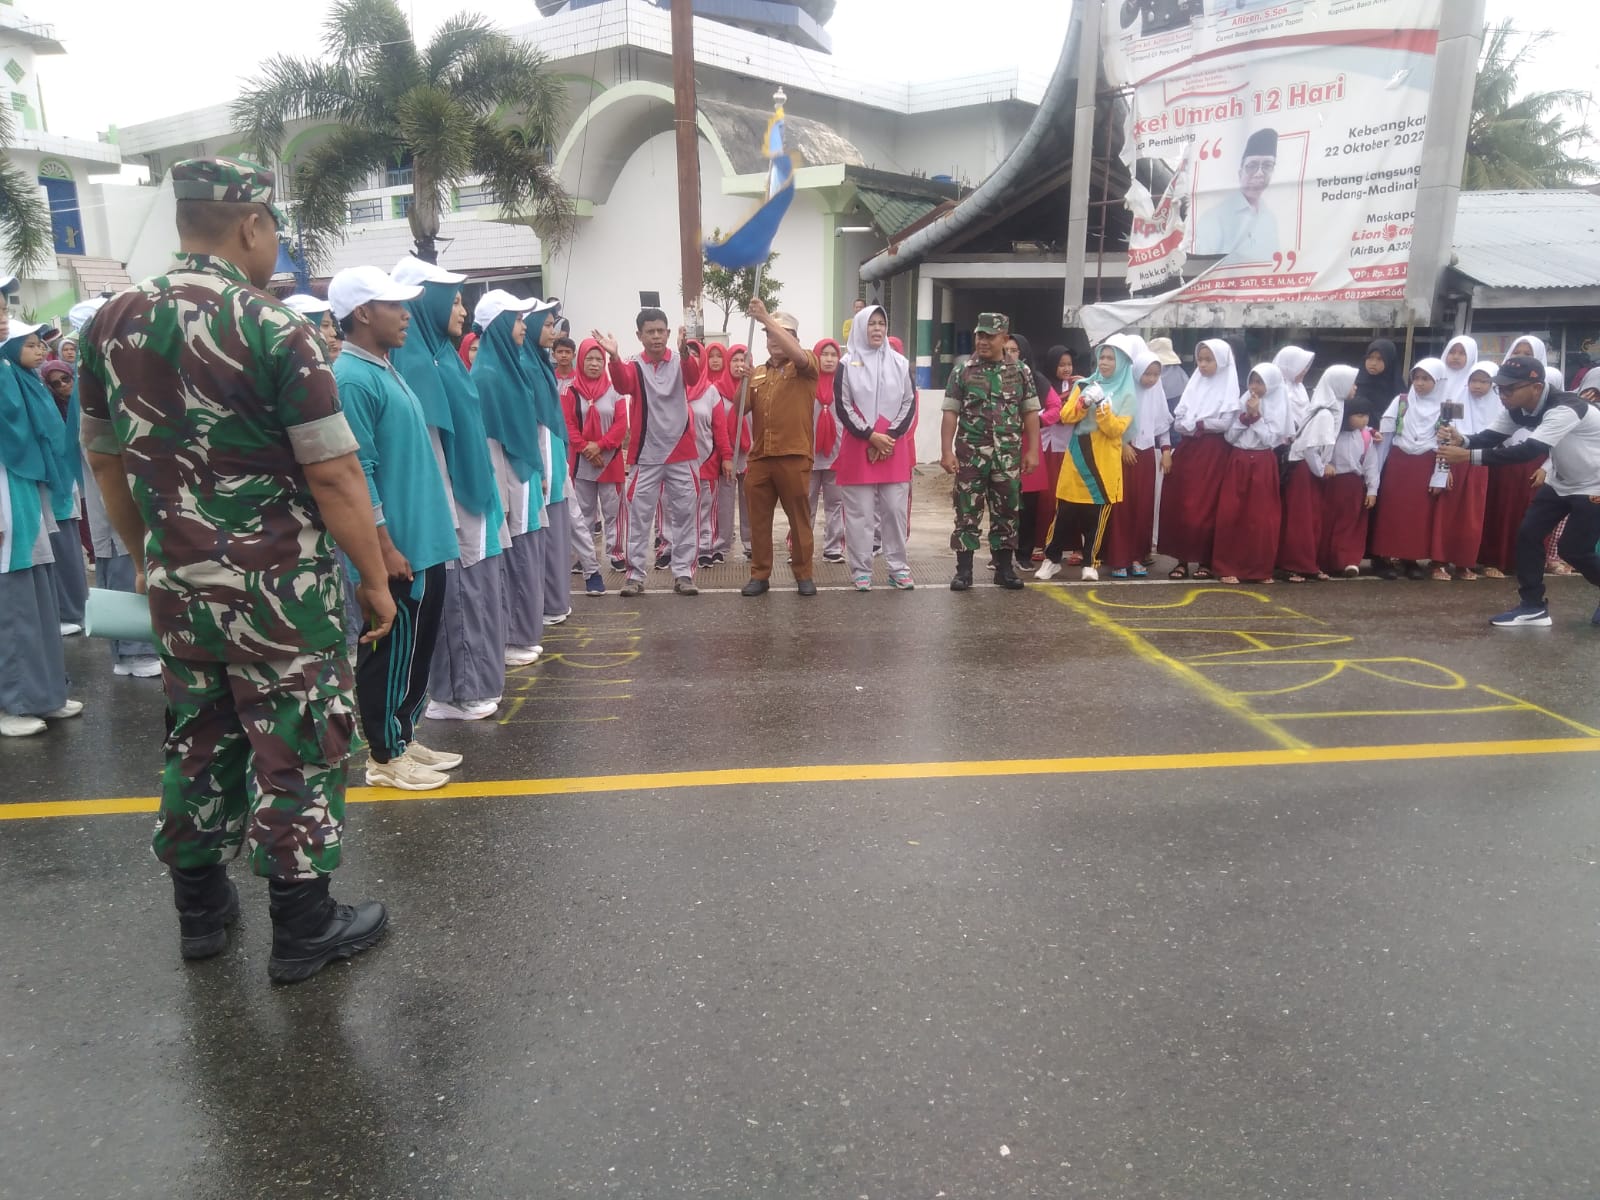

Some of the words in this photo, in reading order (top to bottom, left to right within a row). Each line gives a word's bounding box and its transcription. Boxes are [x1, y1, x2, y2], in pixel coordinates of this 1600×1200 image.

[1253, 88, 1281, 114] 12
[1289, 74, 1344, 107] Hari
[1324, 145, 1340, 158] 22
[1394, 130, 1425, 147] 2022
[1316, 174, 1363, 188] Terbang
[1365, 165, 1421, 182] Langsung
[1352, 229, 1382, 242] Lion
[1135, 242, 1166, 264] Hotel
